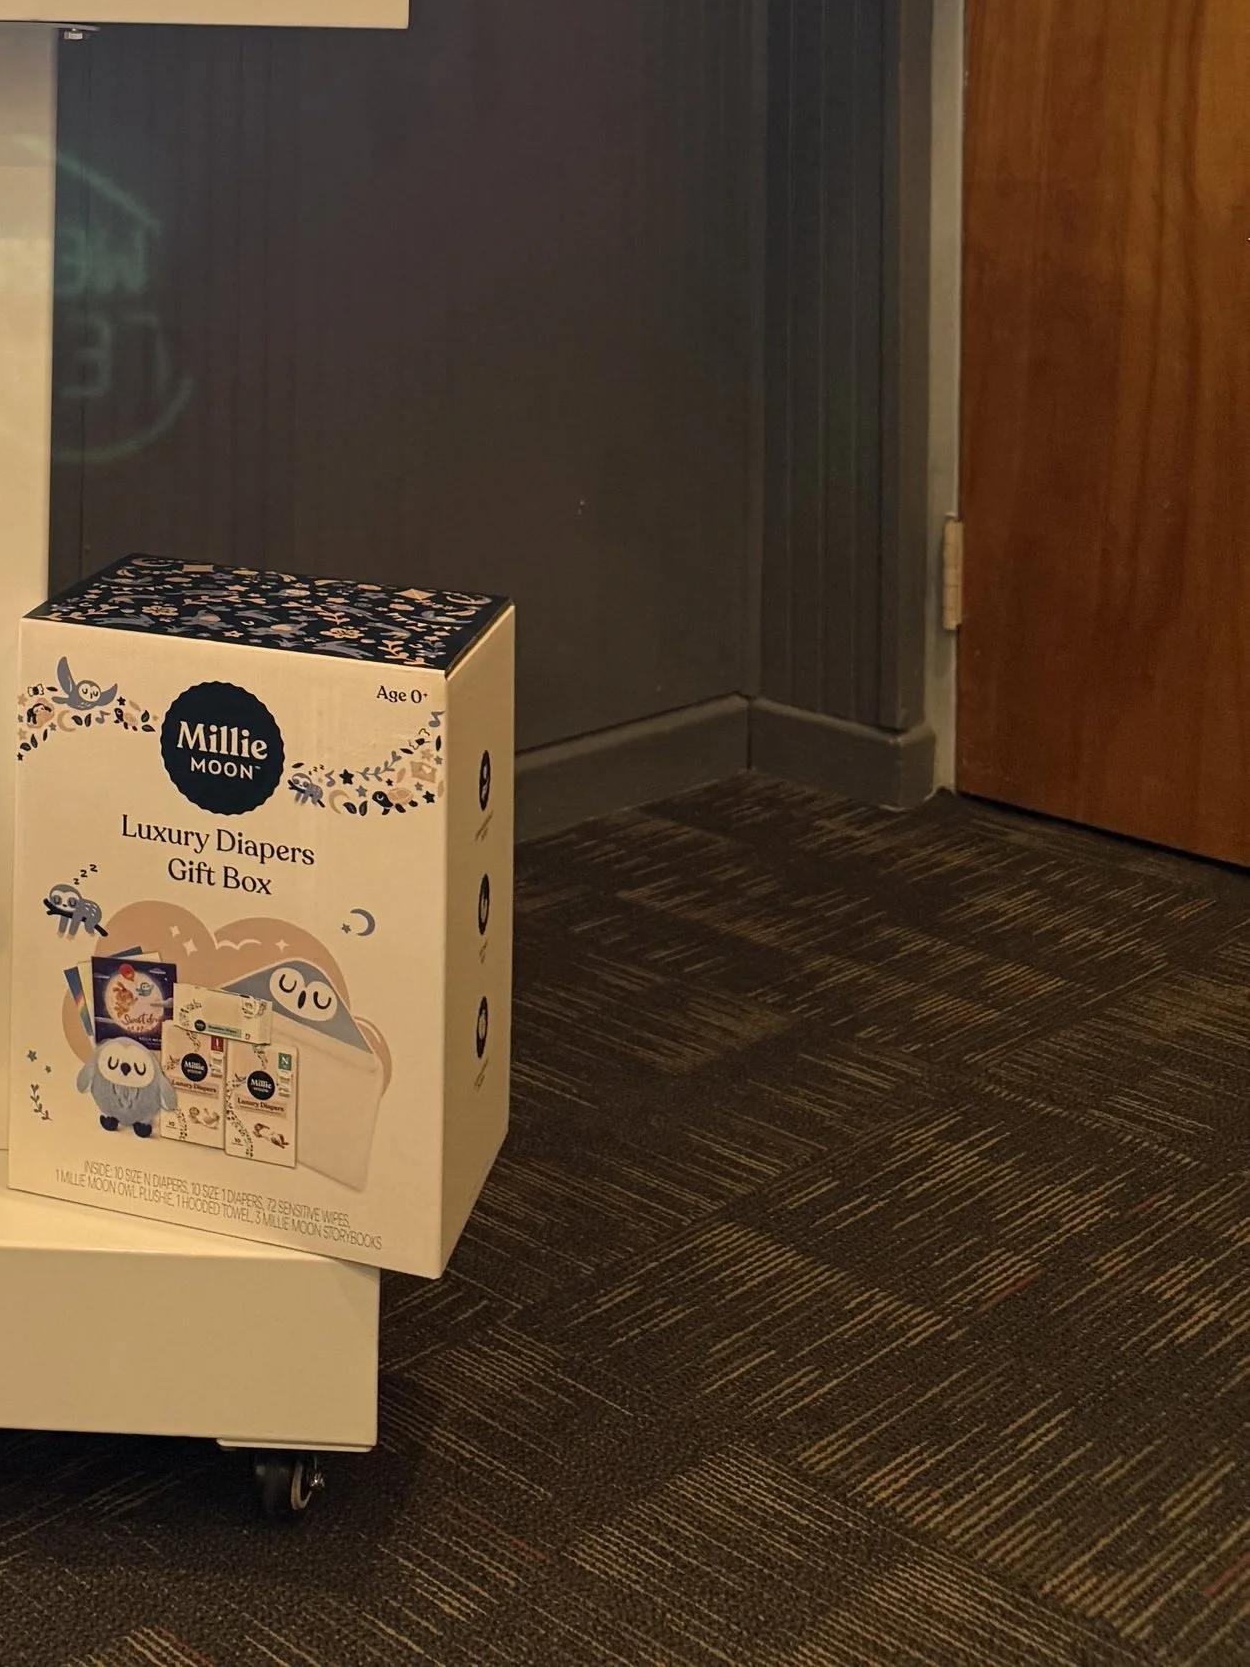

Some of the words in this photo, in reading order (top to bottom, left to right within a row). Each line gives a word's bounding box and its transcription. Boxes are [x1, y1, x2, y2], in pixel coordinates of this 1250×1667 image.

[376, 685, 407, 703] Age
[176, 720, 269, 761] Millie
[121, 814, 210, 855] Luxury
[216, 829, 316, 866] Diapers
[167, 858, 216, 886] Gift
[223, 866, 273, 896] Box
[184, 1060, 205, 1072] Millie
[193, 1084, 217, 1094] Diapers
[250, 1078, 272, 1090] Millie
[237, 1097, 260, 1108] Luxury
[260, 1102, 285, 1113] Diapers
[114, 1166, 124, 1180] 10
[125, 1168, 143, 1185] SIZE
[144, 1172, 151, 1186] N
[191, 1182, 201, 1196] 10
[202, 1184, 220, 1200] SIZE
[266, 1197, 277, 1213] 72
[278, 1200, 321, 1223] SENSITIVE
[60, 1170, 87, 1188] MILLIE
[87, 1174, 116, 1194] MOON
[117, 1182, 138, 1199] OWL
[182, 1195, 221, 1215] HOODED
[255, 1210, 261, 1225] 3
[262, 1212, 290, 1231] MILLIE
[291, 1218, 322, 1237] MOON
[322, 1224, 383, 1251] STORYBOOKS
